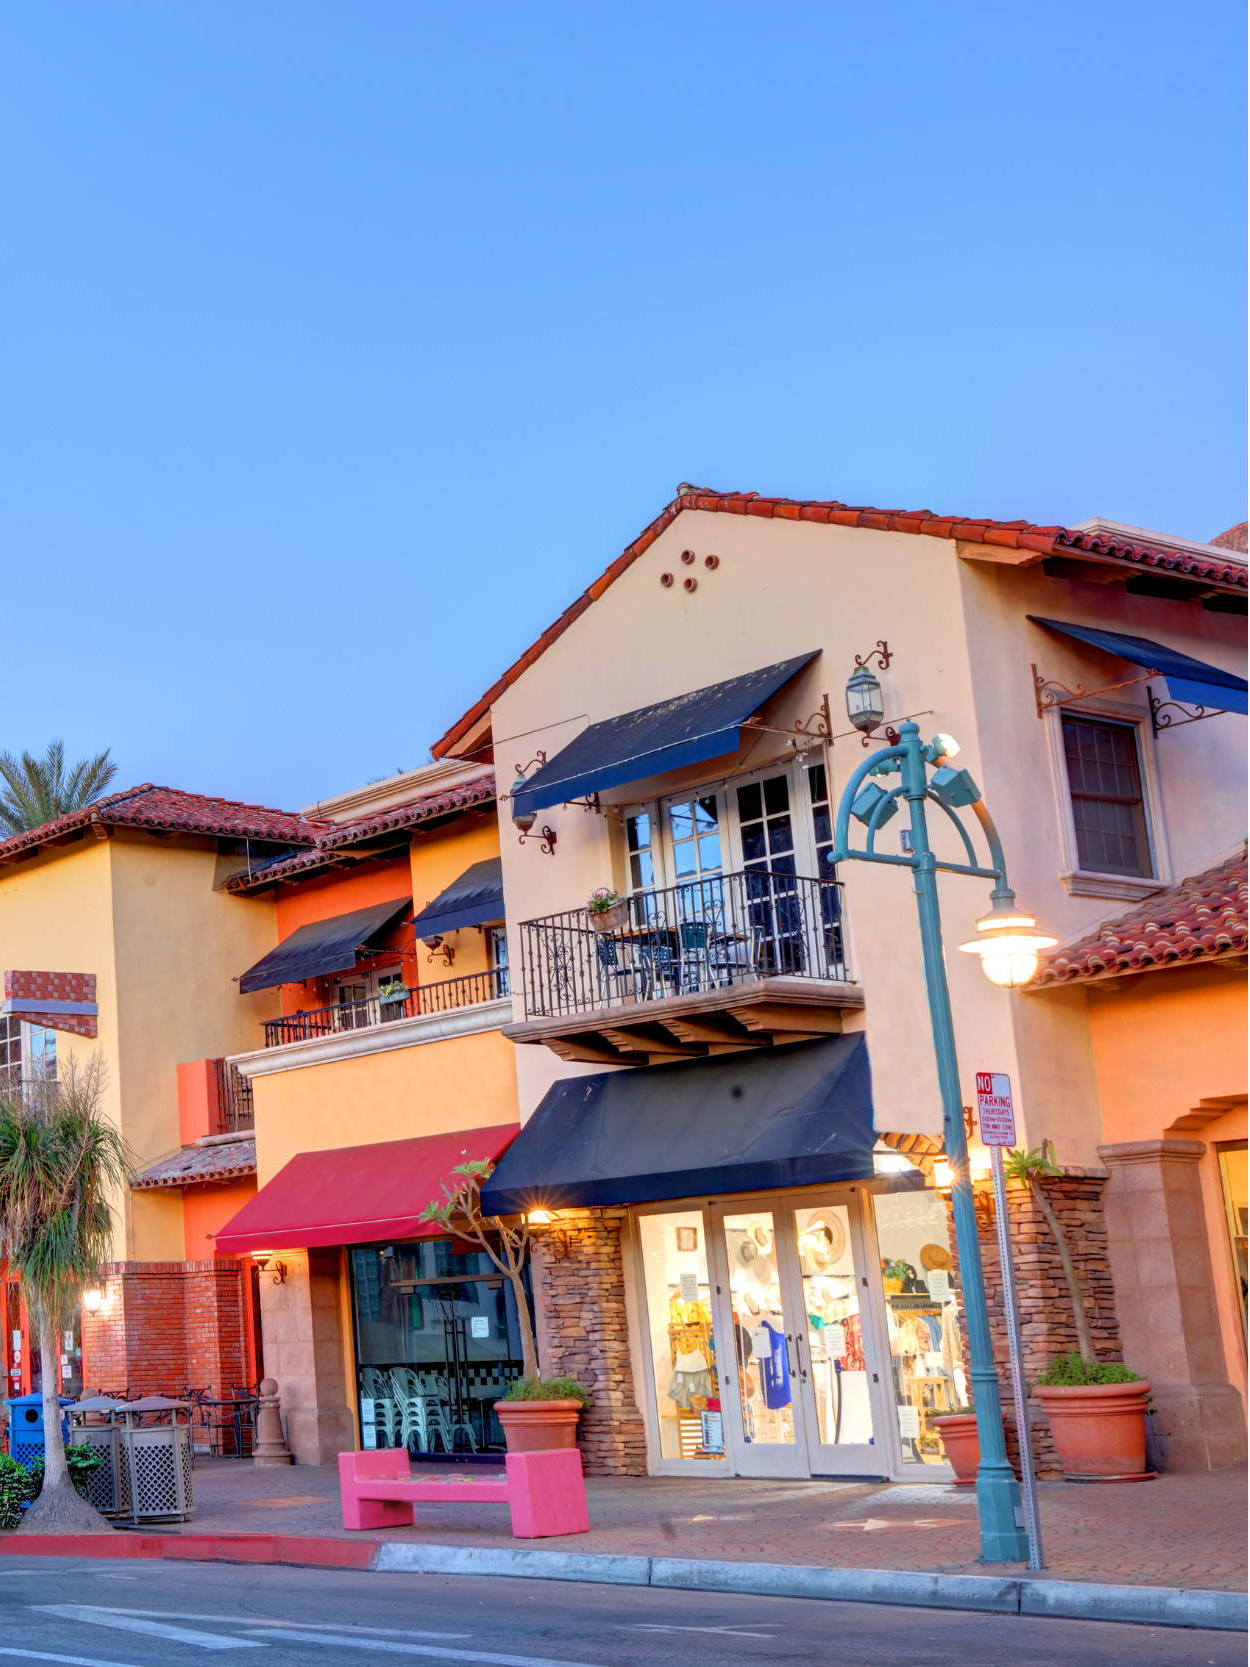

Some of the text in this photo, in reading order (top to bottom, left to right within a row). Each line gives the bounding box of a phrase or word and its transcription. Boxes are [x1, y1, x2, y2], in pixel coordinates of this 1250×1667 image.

[977, 1075, 991, 1092] NO
[980, 1095, 1010, 1108] PARKING
[983, 1108, 1010, 1116] THURSDAYS
